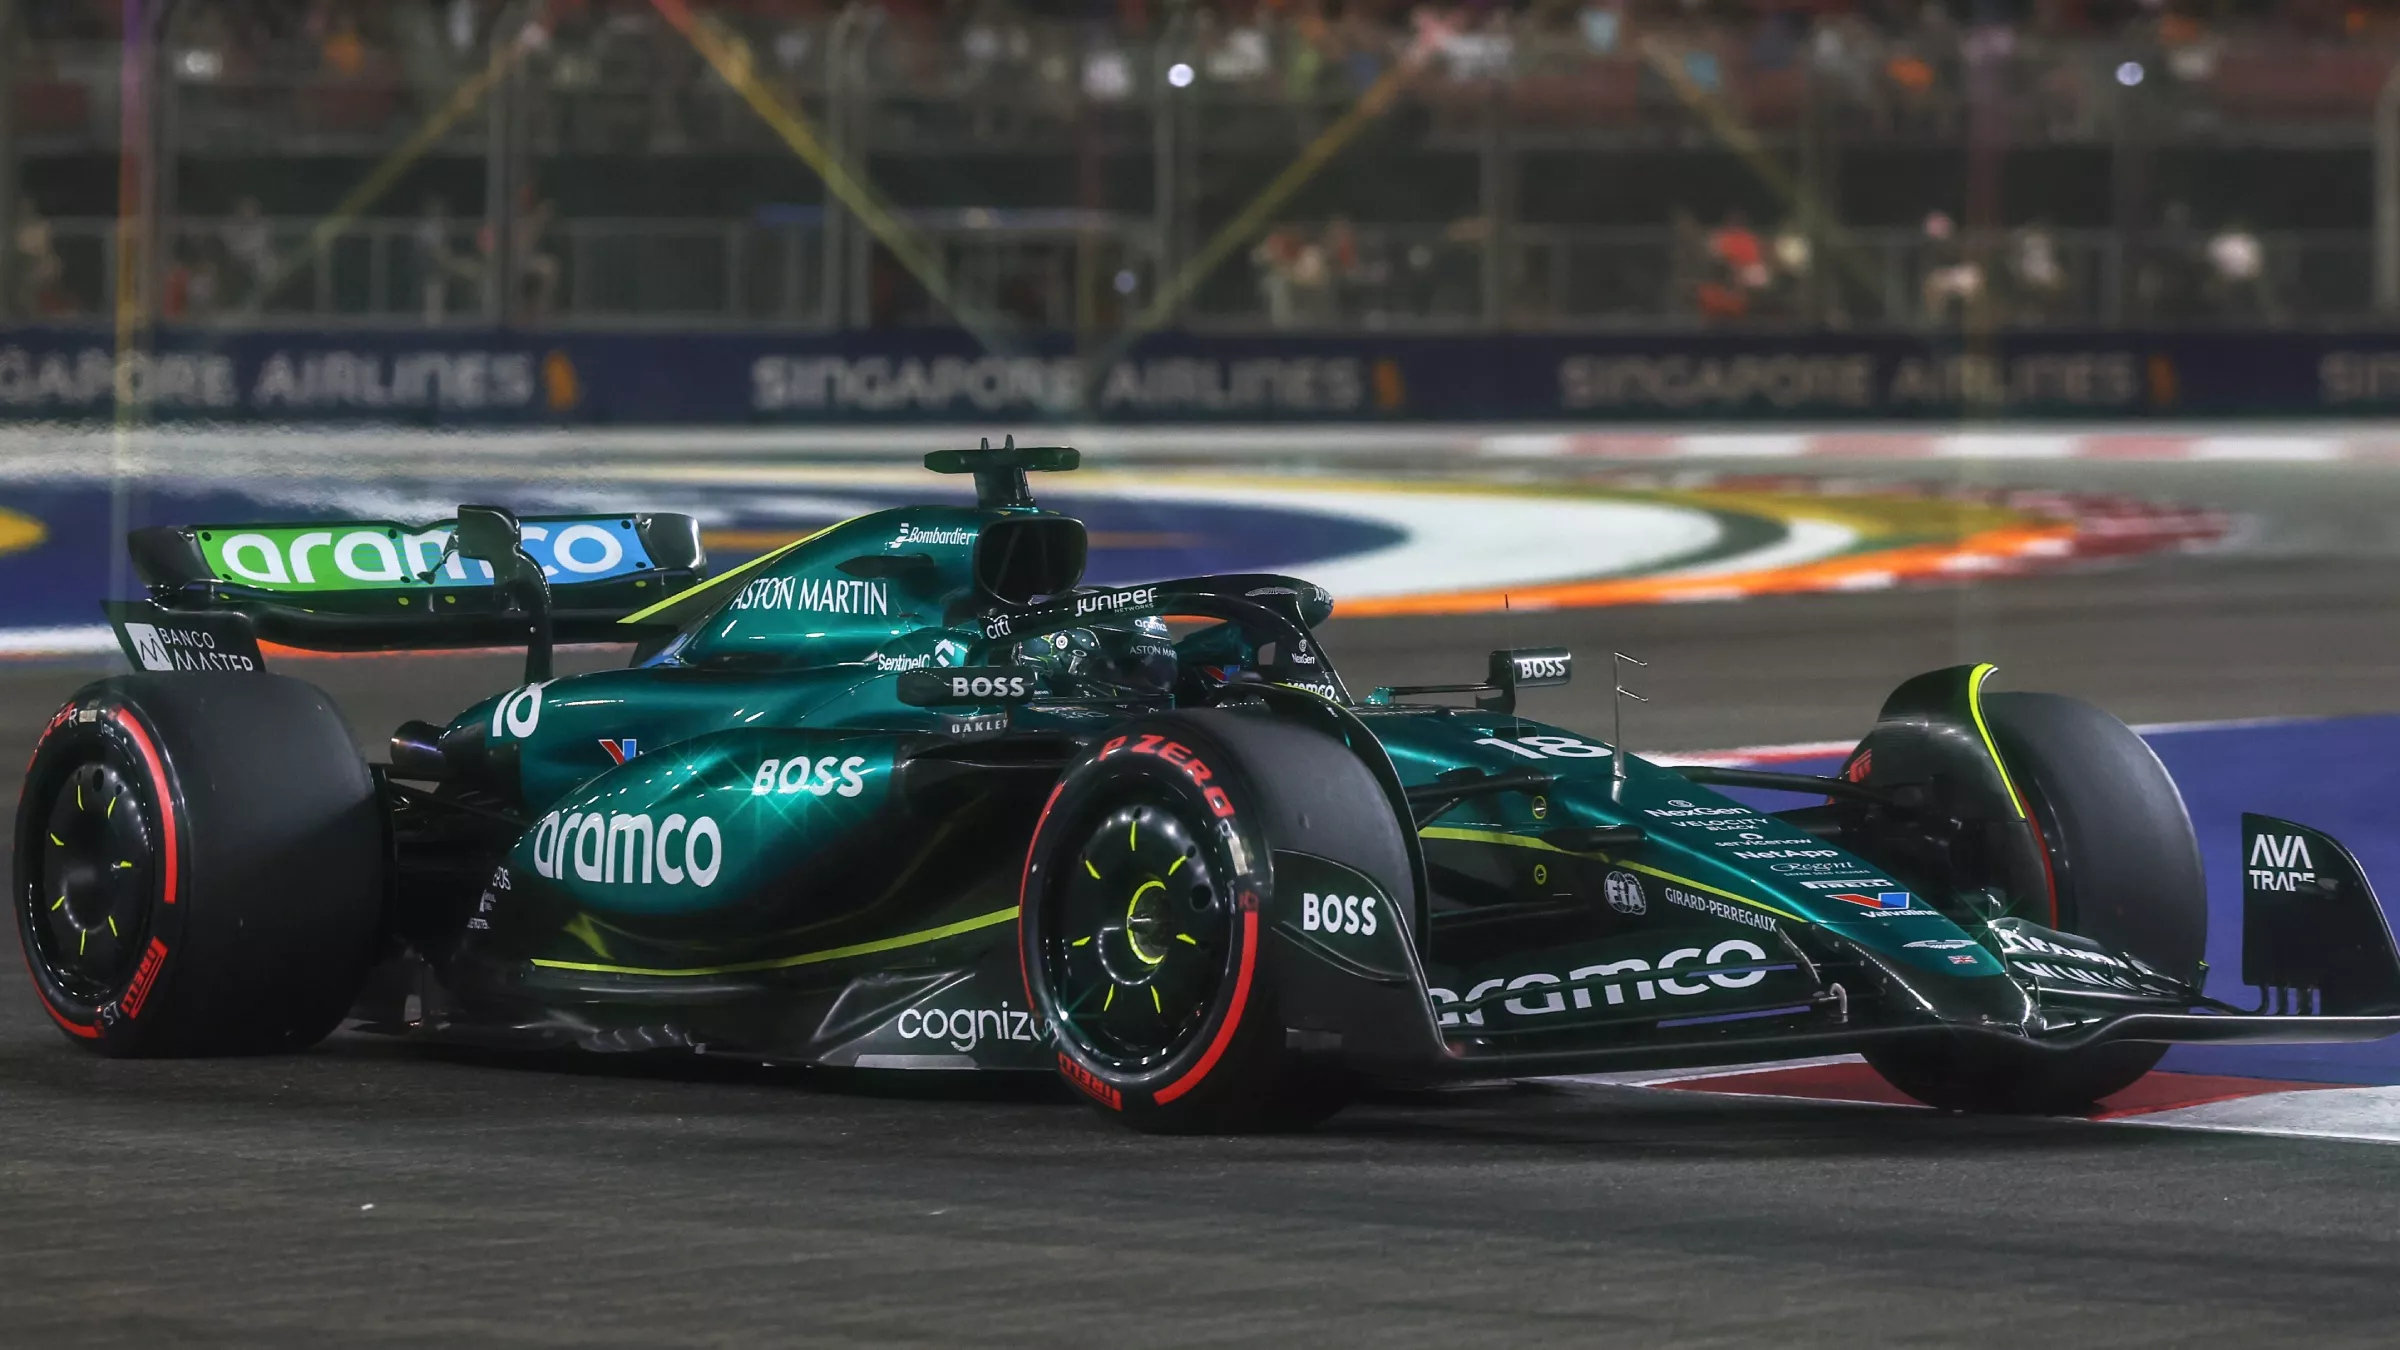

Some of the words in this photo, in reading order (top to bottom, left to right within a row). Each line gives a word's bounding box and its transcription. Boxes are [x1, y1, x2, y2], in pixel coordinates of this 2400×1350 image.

[907, 527, 972, 545] Bombardier
[729, 576, 796, 611] ASTON
[798, 578, 888, 616] MARTIN
[1114, 602, 1155, 614] NETWORKS
[158, 627, 216, 649] BANCO
[986, 615, 1013, 640] citi
[1129, 645, 1161, 655] ASTON
[1521, 660, 1567, 679] BOSS
[952, 677, 1025, 697] BOSS
[951, 719, 1009, 734] OAKLEY
[1472, 736, 1613, 760] 18
[752, 756, 866, 798] BOSS
[1131, 734, 1236, 817] ZERO
[1643, 807, 1752, 818] NexGen
[1671, 818, 1769, 828] VELOCITY
[534, 811, 723, 888] aramco
[1733, 849, 1839, 861] NetApp
[2250, 833, 2314, 870] AVA
[1799, 879, 1896, 889] PIRELLI
[1303, 892, 1377, 936] BOSS
[1664, 887, 1777, 933] GIRARD-PERREGAUX
